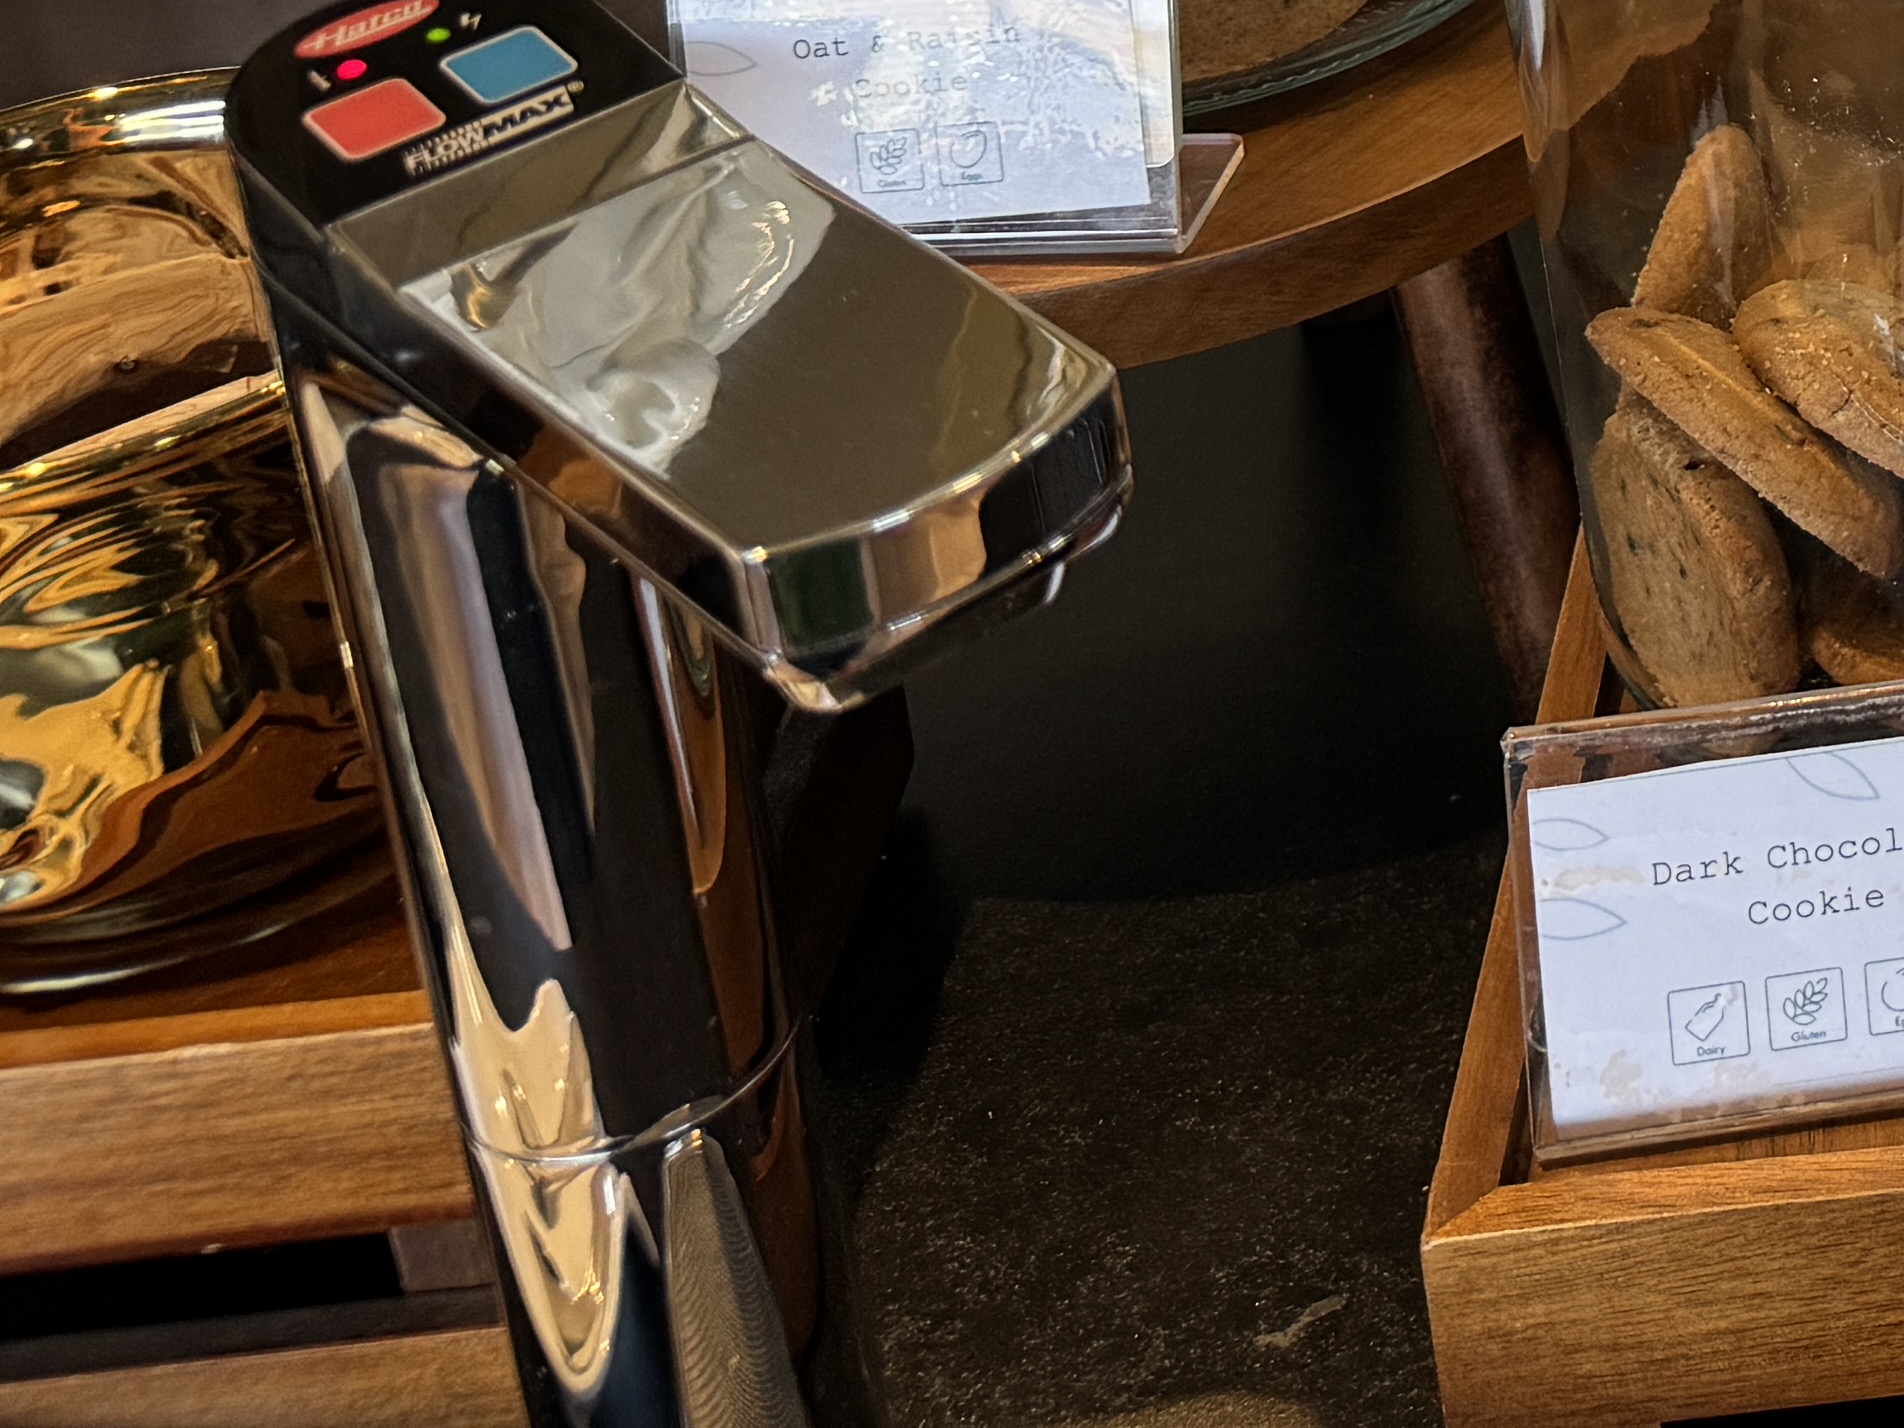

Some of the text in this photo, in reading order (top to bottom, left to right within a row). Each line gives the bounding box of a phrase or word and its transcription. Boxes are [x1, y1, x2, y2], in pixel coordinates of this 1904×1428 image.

[793, 36, 849, 59] Oat
[871, 35, 885, 53] &
[855, 71, 968, 98] Cookie
[1652, 851, 1744, 886] Dark
[1748, 886, 1885, 925] Cookie
[1790, 1030, 1827, 1042] Gluten
[1697, 1045, 1725, 1057] Dairy
